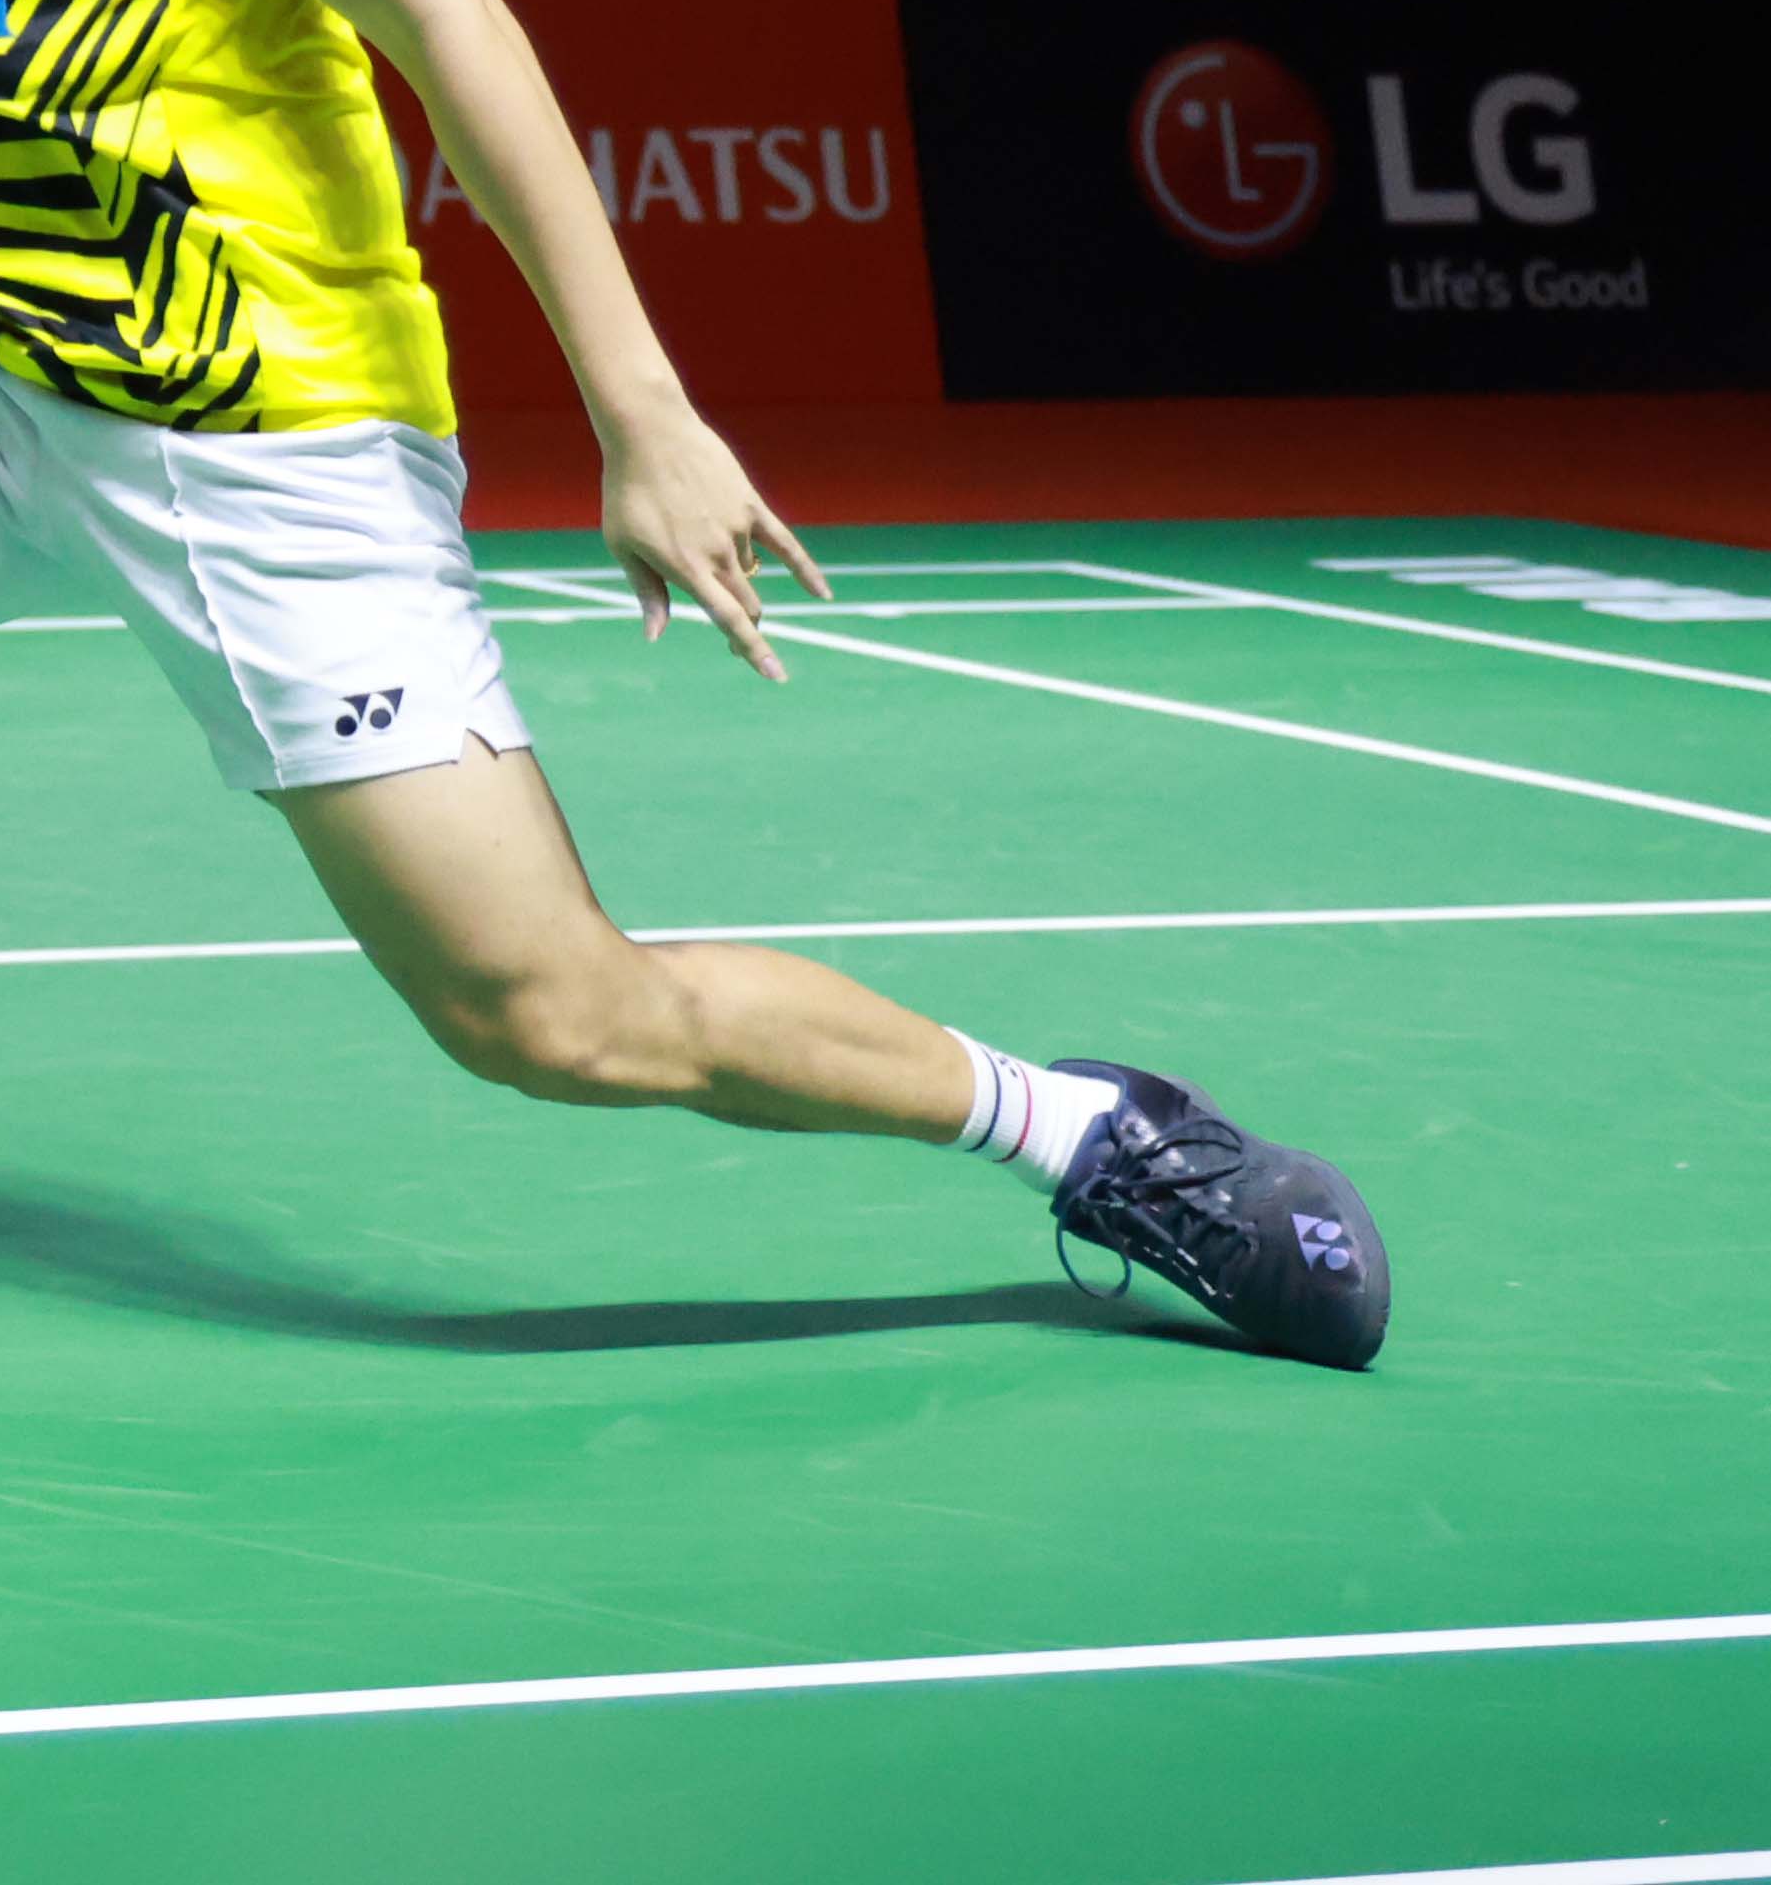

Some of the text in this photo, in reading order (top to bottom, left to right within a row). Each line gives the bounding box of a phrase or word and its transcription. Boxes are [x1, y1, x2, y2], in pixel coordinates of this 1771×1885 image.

[1366, 72, 1598, 225] LG
[1389, 255, 1649, 310] Life's Good
